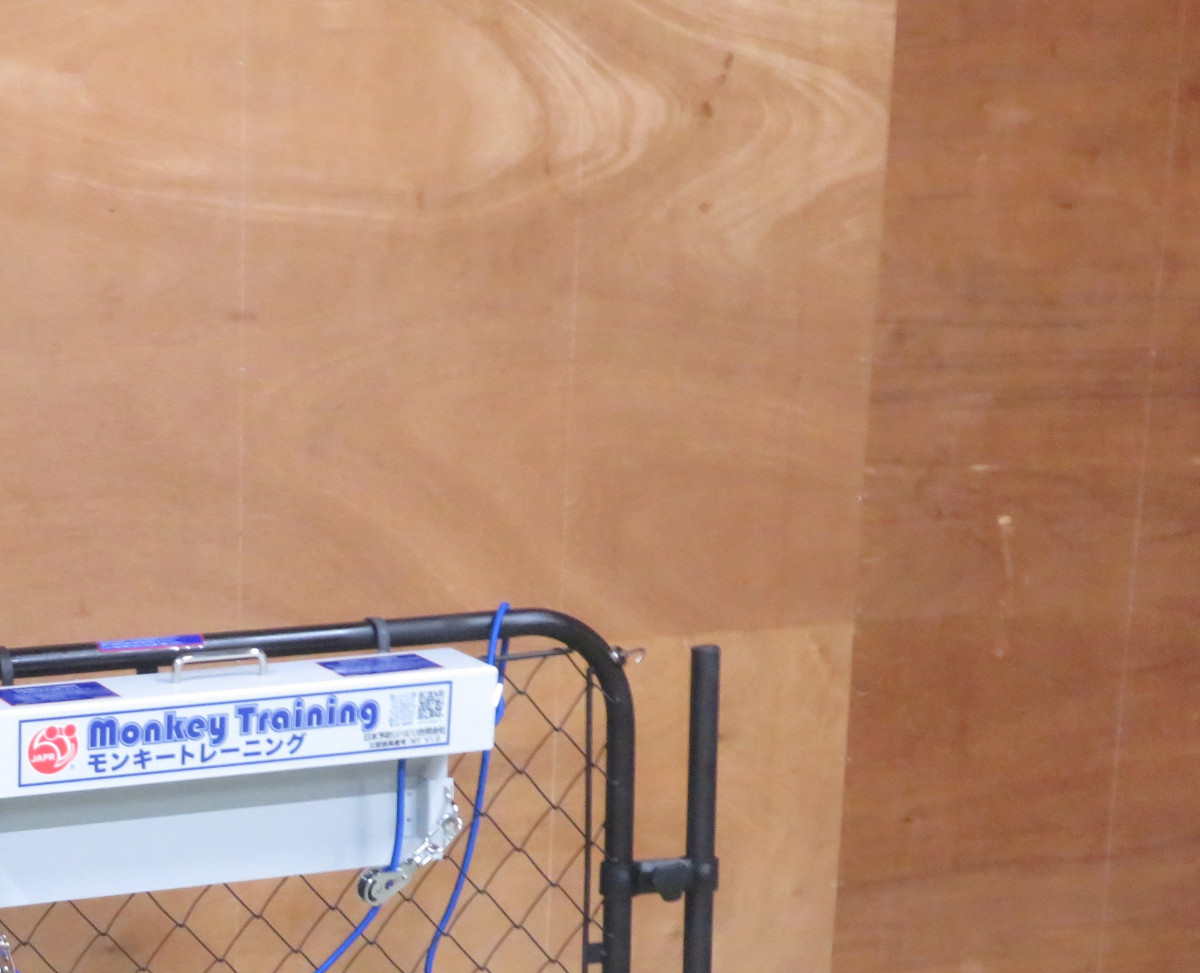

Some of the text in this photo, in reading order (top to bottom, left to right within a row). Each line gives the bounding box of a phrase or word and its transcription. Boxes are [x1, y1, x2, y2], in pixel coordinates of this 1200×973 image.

[88, 693, 381, 750] Monkey Training
[88, 733, 307, 773] モンキートレーニング
